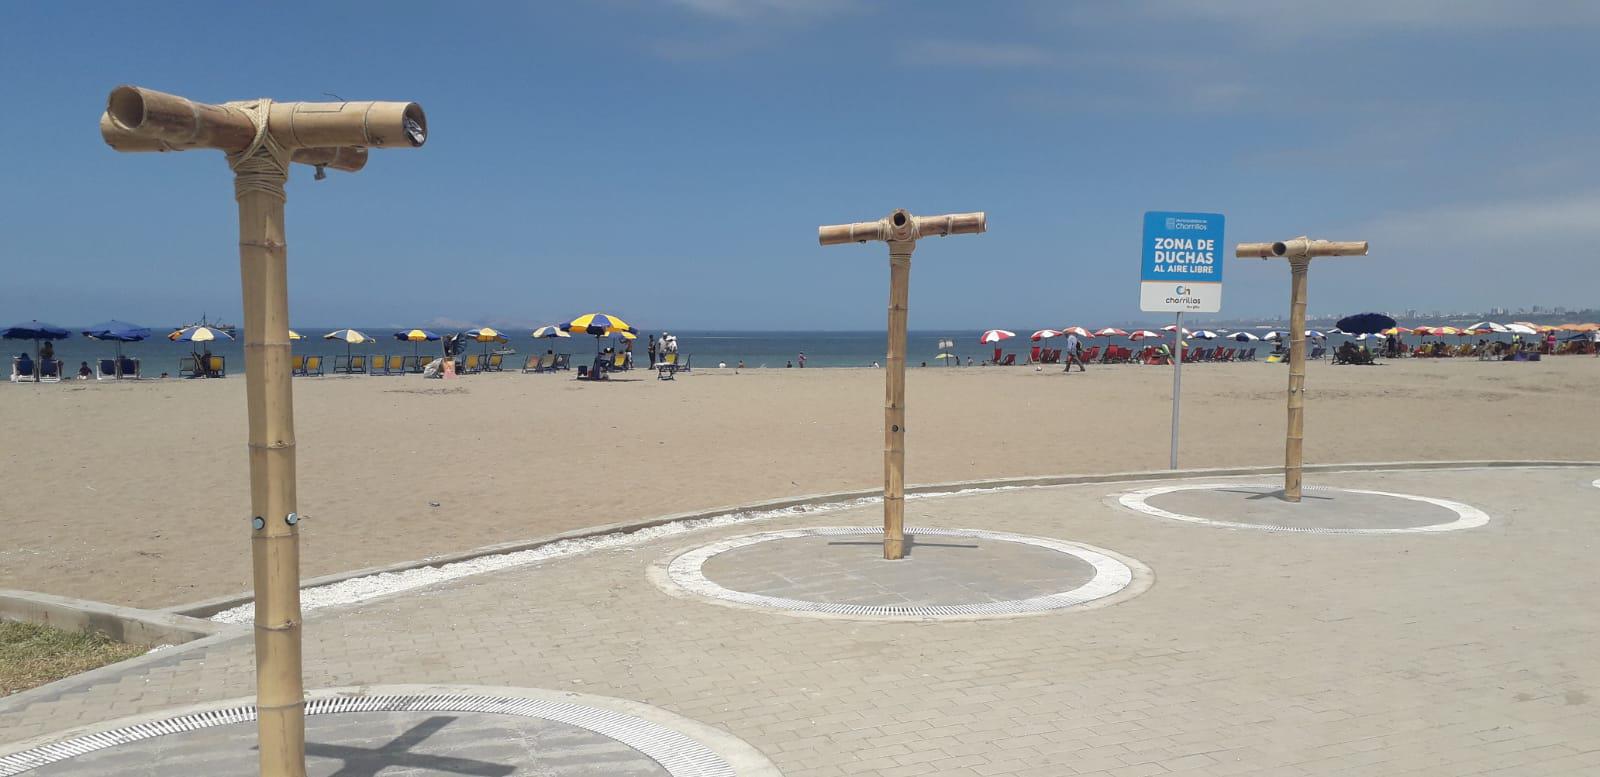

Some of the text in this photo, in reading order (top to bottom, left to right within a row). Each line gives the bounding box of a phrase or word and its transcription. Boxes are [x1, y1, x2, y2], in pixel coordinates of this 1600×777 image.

[1154, 238, 1214, 251] ZONA DE
[1154, 251, 1214, 264] DUCHAS
[1153, 264, 1213, 274] AL AIRE LIBRE
